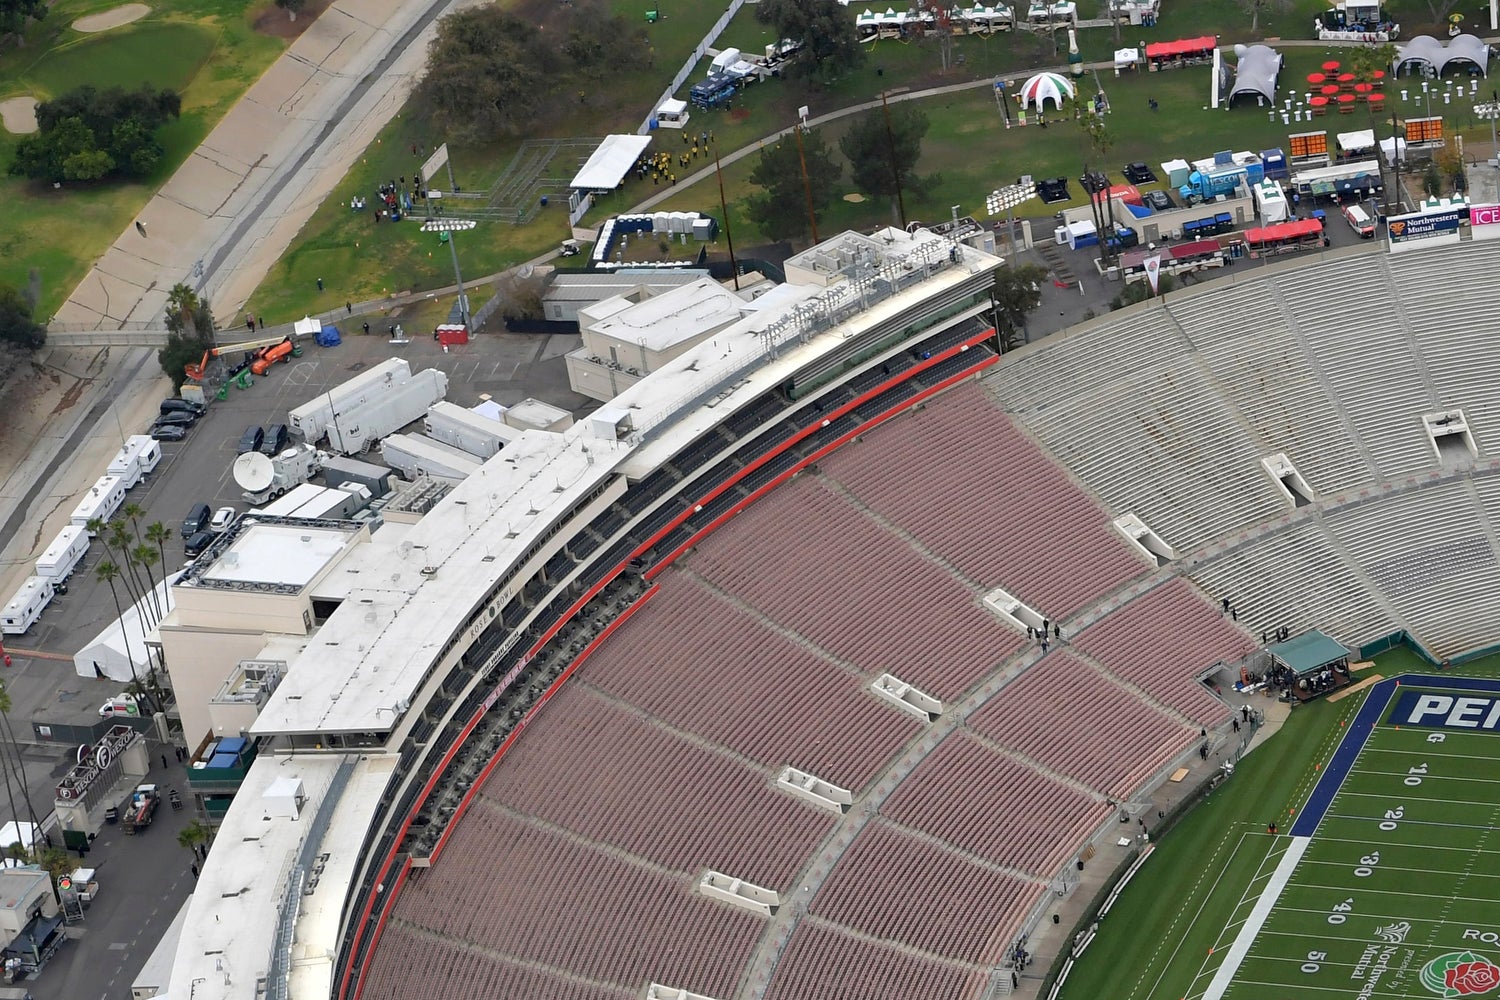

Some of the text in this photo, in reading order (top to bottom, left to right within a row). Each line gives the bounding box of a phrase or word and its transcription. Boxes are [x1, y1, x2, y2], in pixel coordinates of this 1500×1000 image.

[1406, 213, 1458, 227] Northwestern
[1475, 209, 1500, 225] ICE
[1407, 224, 1435, 234] Mutual
[111, 729, 134, 758] WESCOM
[1426, 733, 1445, 743] G
[75, 766, 100, 794] WESCOM
[1404, 766, 1427, 786] 10
[1379, 810, 1403, 831] 20
[1354, 855, 1379, 877] 30
[1327, 902, 1352, 924] 40
[1301, 951, 1328, 973] 50
[1350, 944, 1380, 979] Mutual
